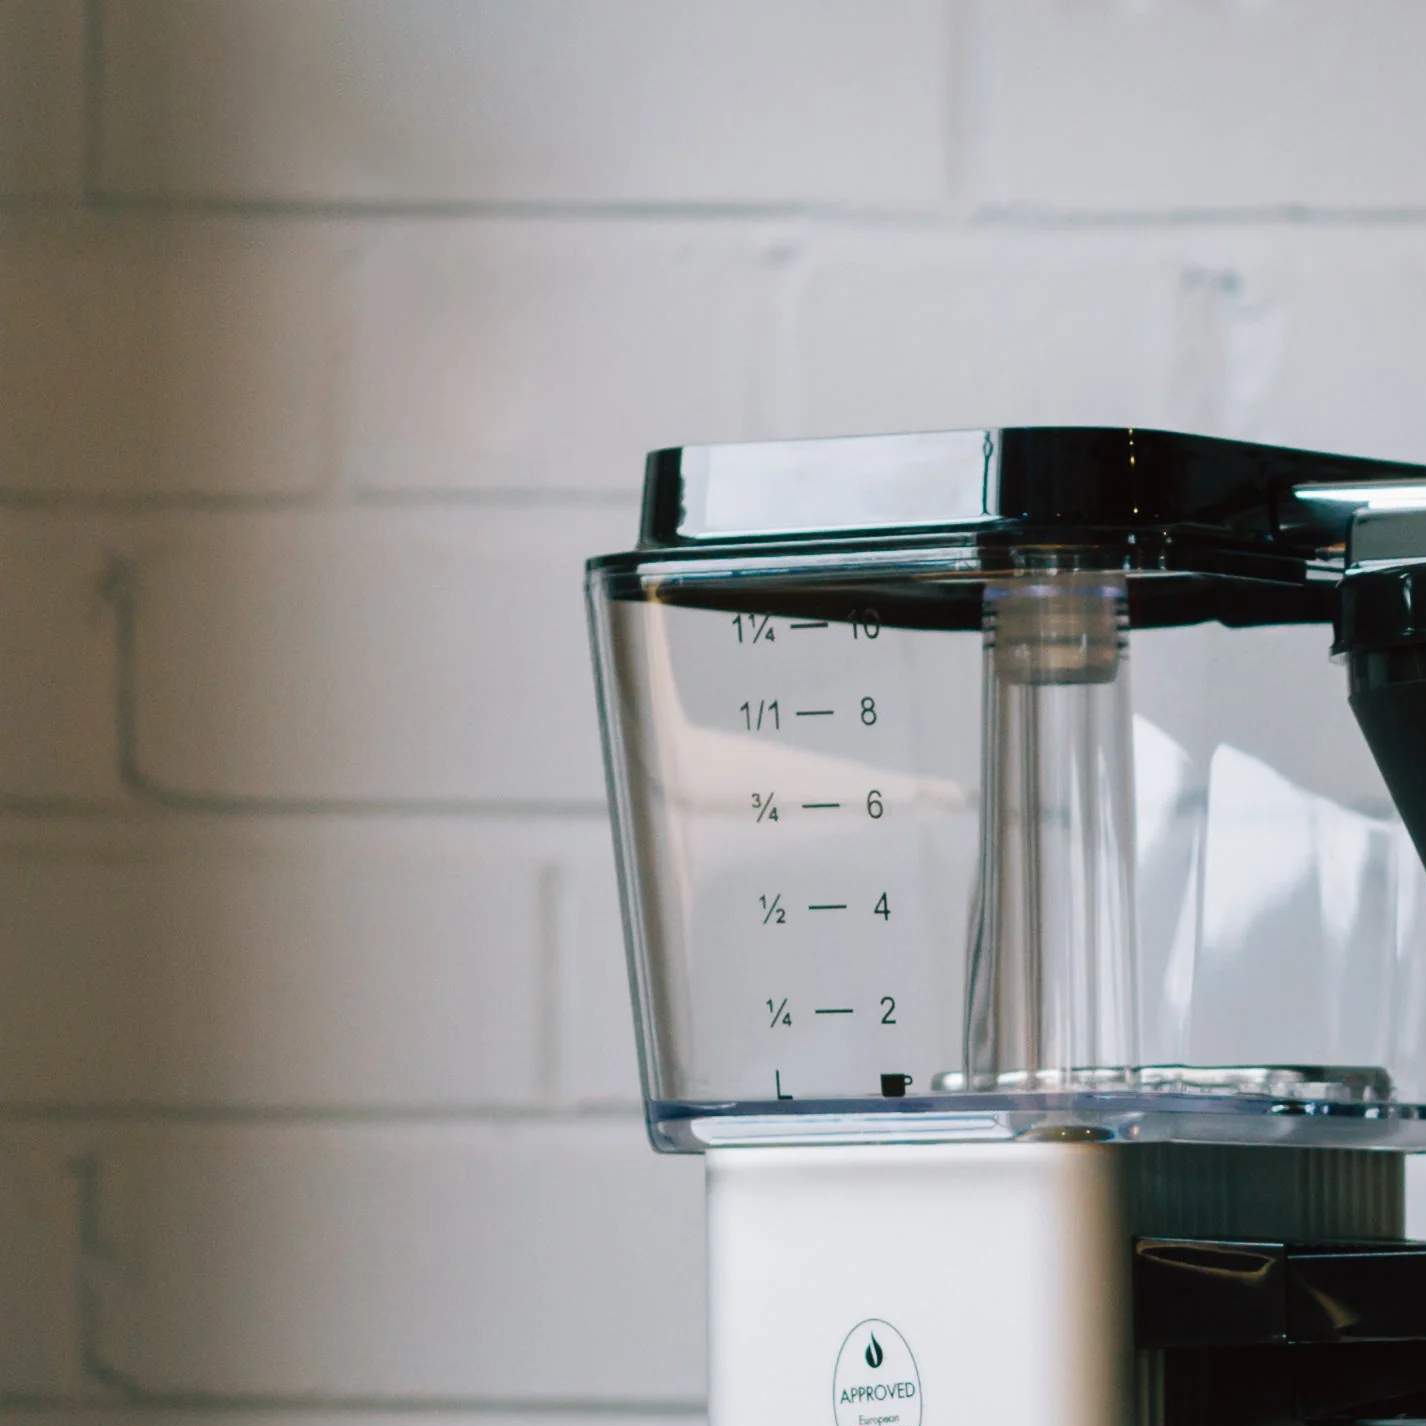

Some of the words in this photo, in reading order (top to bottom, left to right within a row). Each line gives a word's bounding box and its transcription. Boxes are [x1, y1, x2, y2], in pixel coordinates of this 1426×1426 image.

[848, 608, 881, 640] 10
[739, 700, 781, 731] 1/1
[859, 696, 878, 726] 8
[866, 789, 884, 819] 6
[874, 891, 891, 922] 4
[880, 995, 897, 1025] 2
[776, 1069, 793, 1100] L
[840, 1382, 916, 1404] APPROVED
[858, 1414, 900, 1426] European
